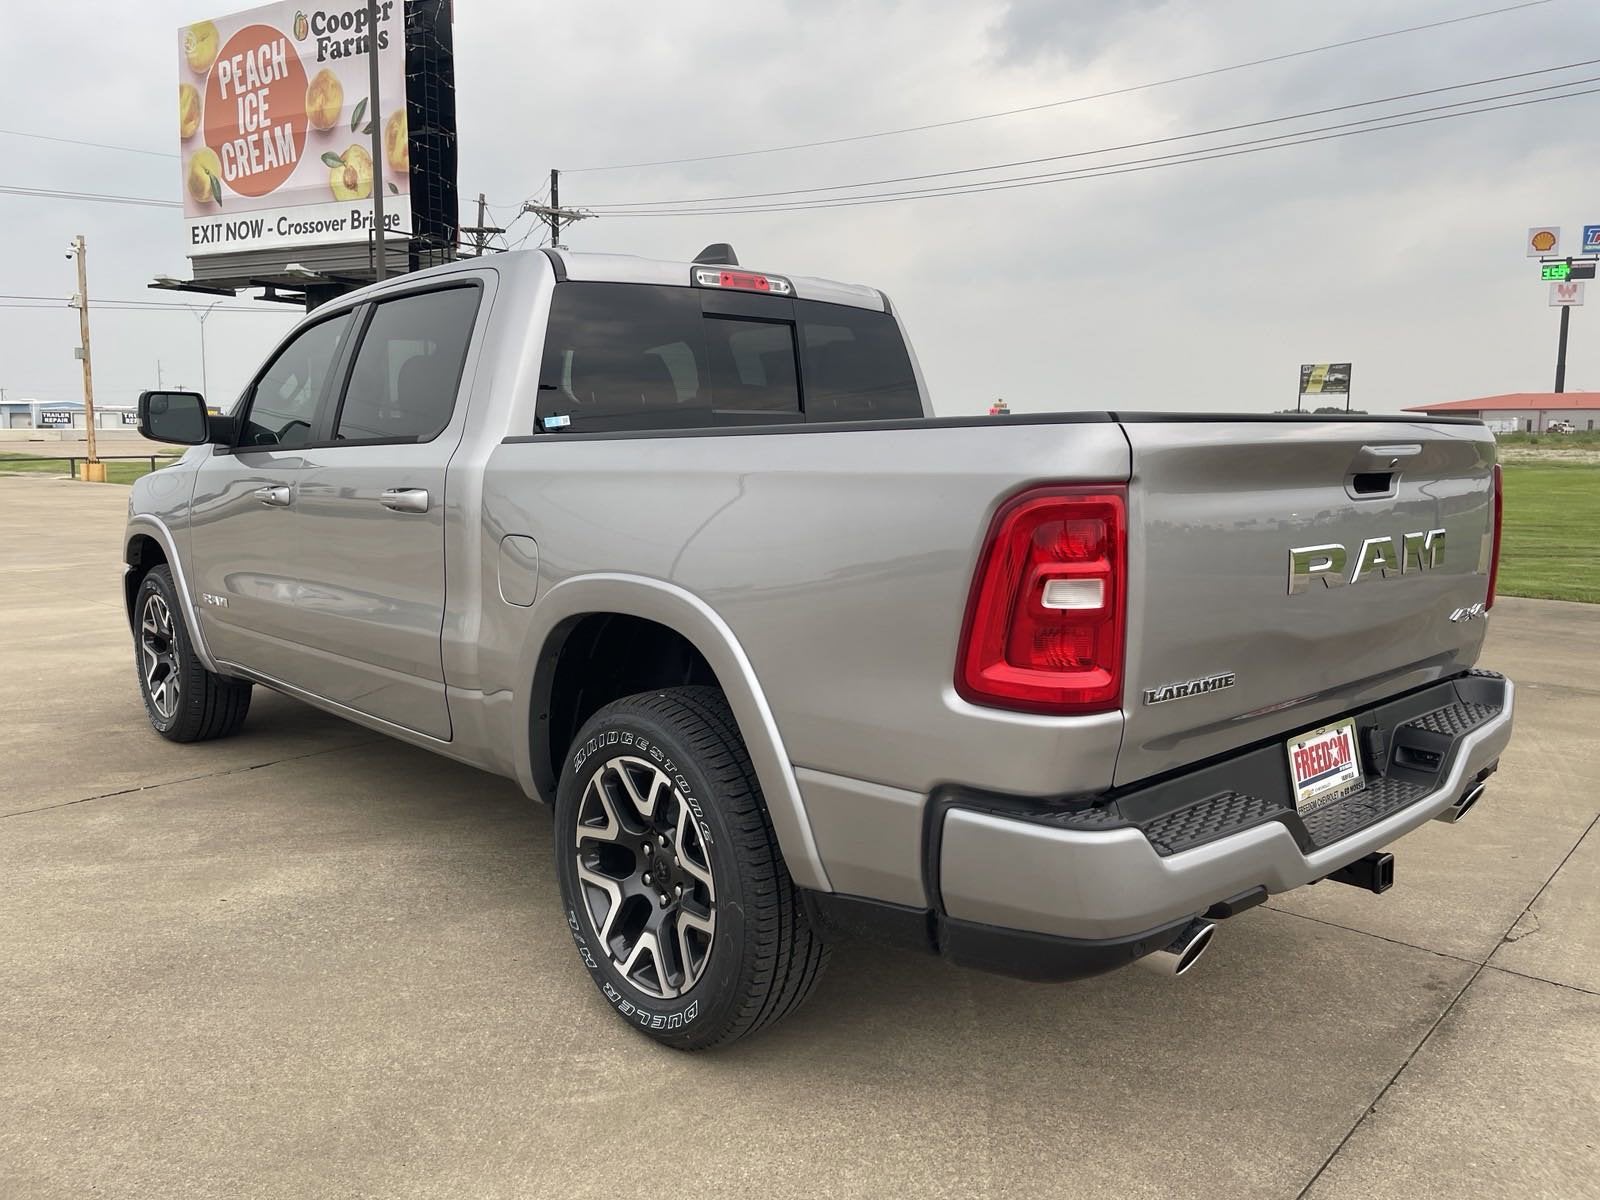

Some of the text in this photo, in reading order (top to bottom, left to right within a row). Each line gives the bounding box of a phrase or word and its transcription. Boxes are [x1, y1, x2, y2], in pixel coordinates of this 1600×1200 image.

[218, 37, 288, 100] PEACH
[316, 30, 389, 62] Farms
[237, 87, 271, 135] ICE
[221, 122, 297, 182] CREAM
[192, 223, 222, 244] EXIT
[226, 218, 264, 241] NOW
[277, 216, 347, 236] Crossover
[351, 209, 400, 230] Brige
[1287, 528, 1446, 595] RAM
[1144, 672, 1235, 705] LARAMIE
[1293, 733, 1352, 782] FREEDOM
[573, 731, 714, 844] BRIDGESTONE
[602, 981, 700, 1030] DUELER
